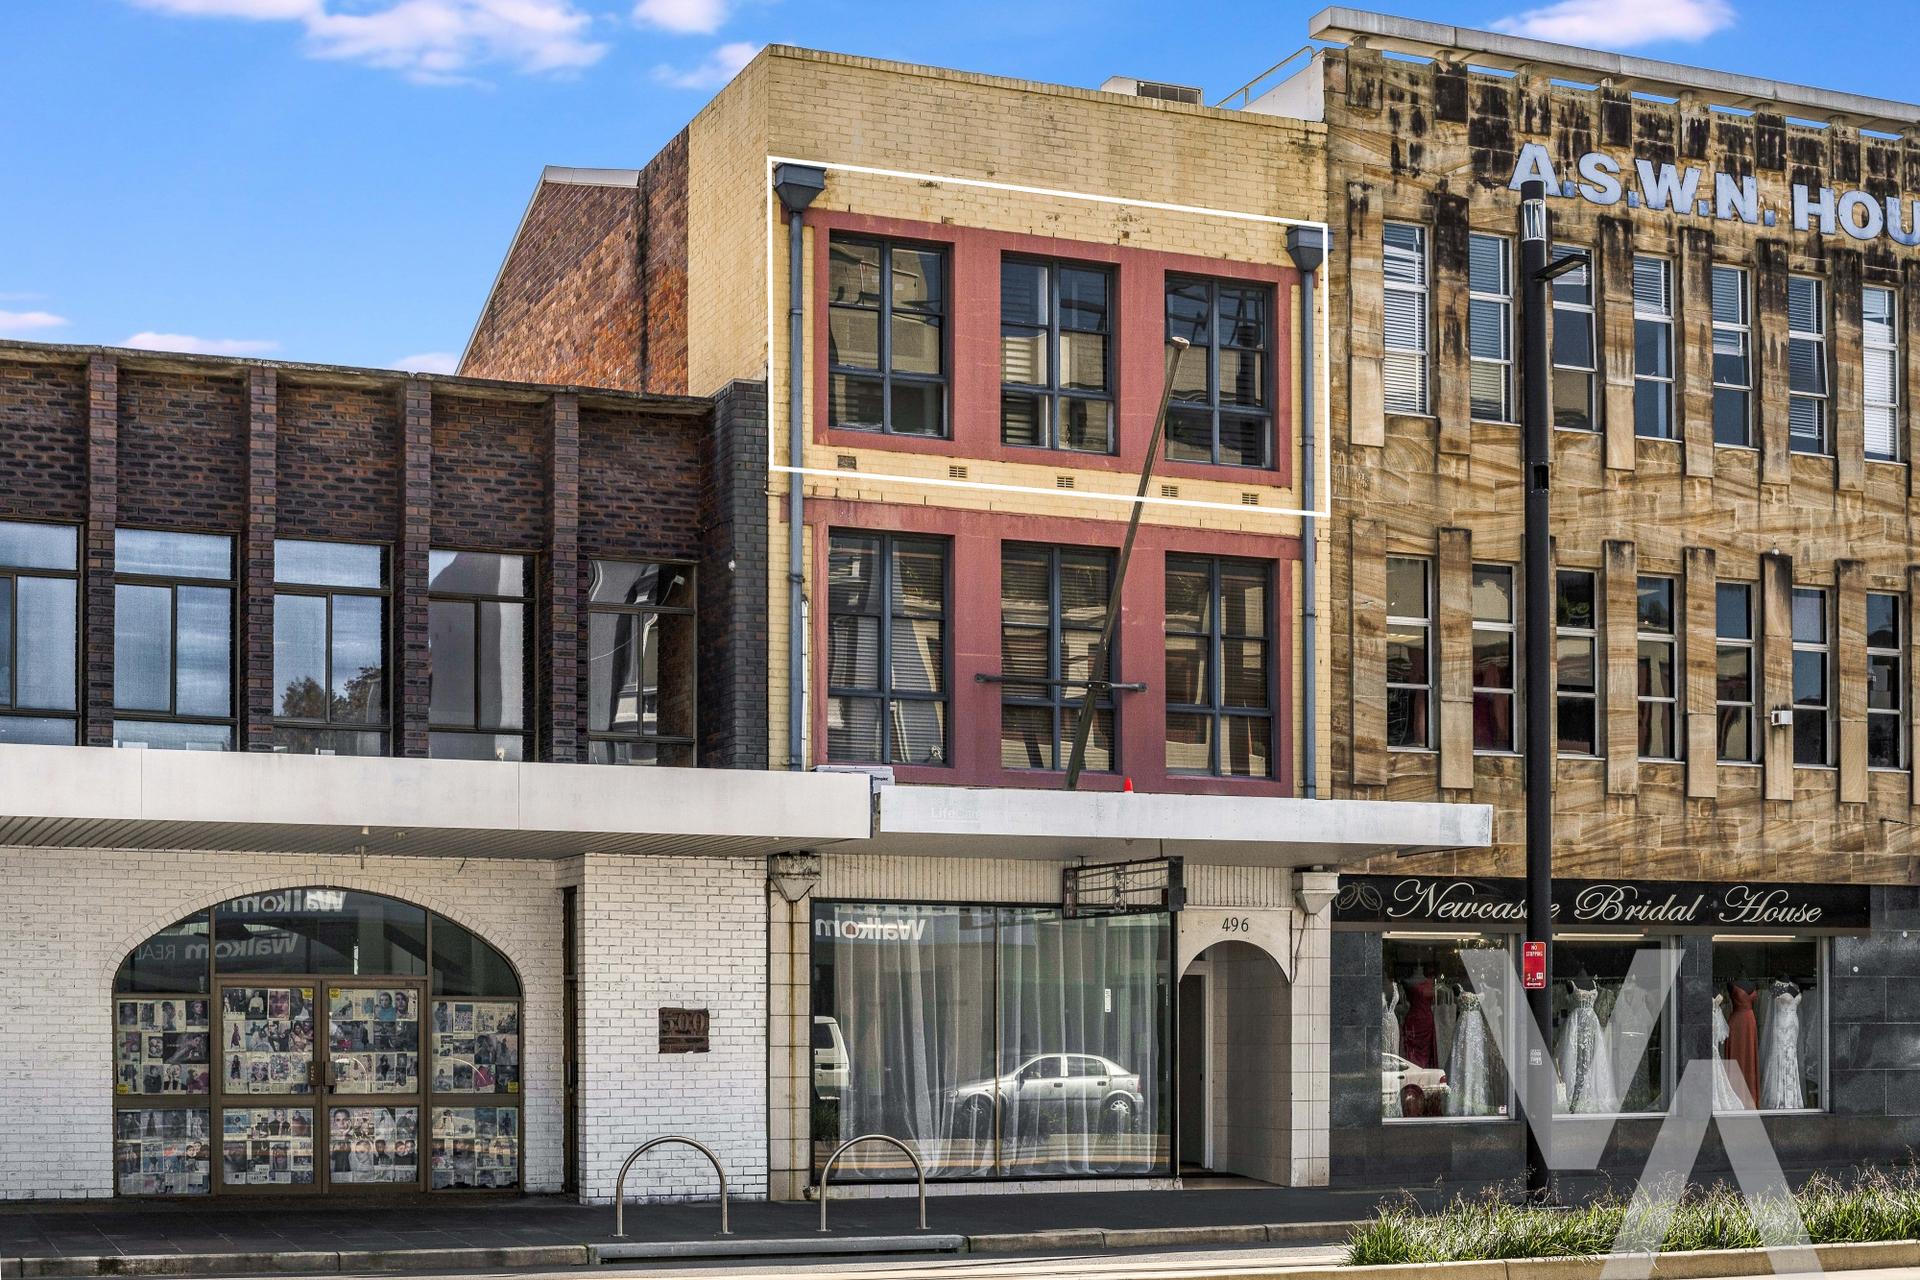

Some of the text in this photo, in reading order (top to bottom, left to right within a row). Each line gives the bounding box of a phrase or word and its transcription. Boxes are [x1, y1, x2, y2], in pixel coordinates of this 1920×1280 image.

[1508, 142, 1776, 227] A.S.W.N.
[1573, 884, 1704, 921] Bridal
[1718, 885, 1822, 923] House
[1221, 917, 1249, 932] 496
